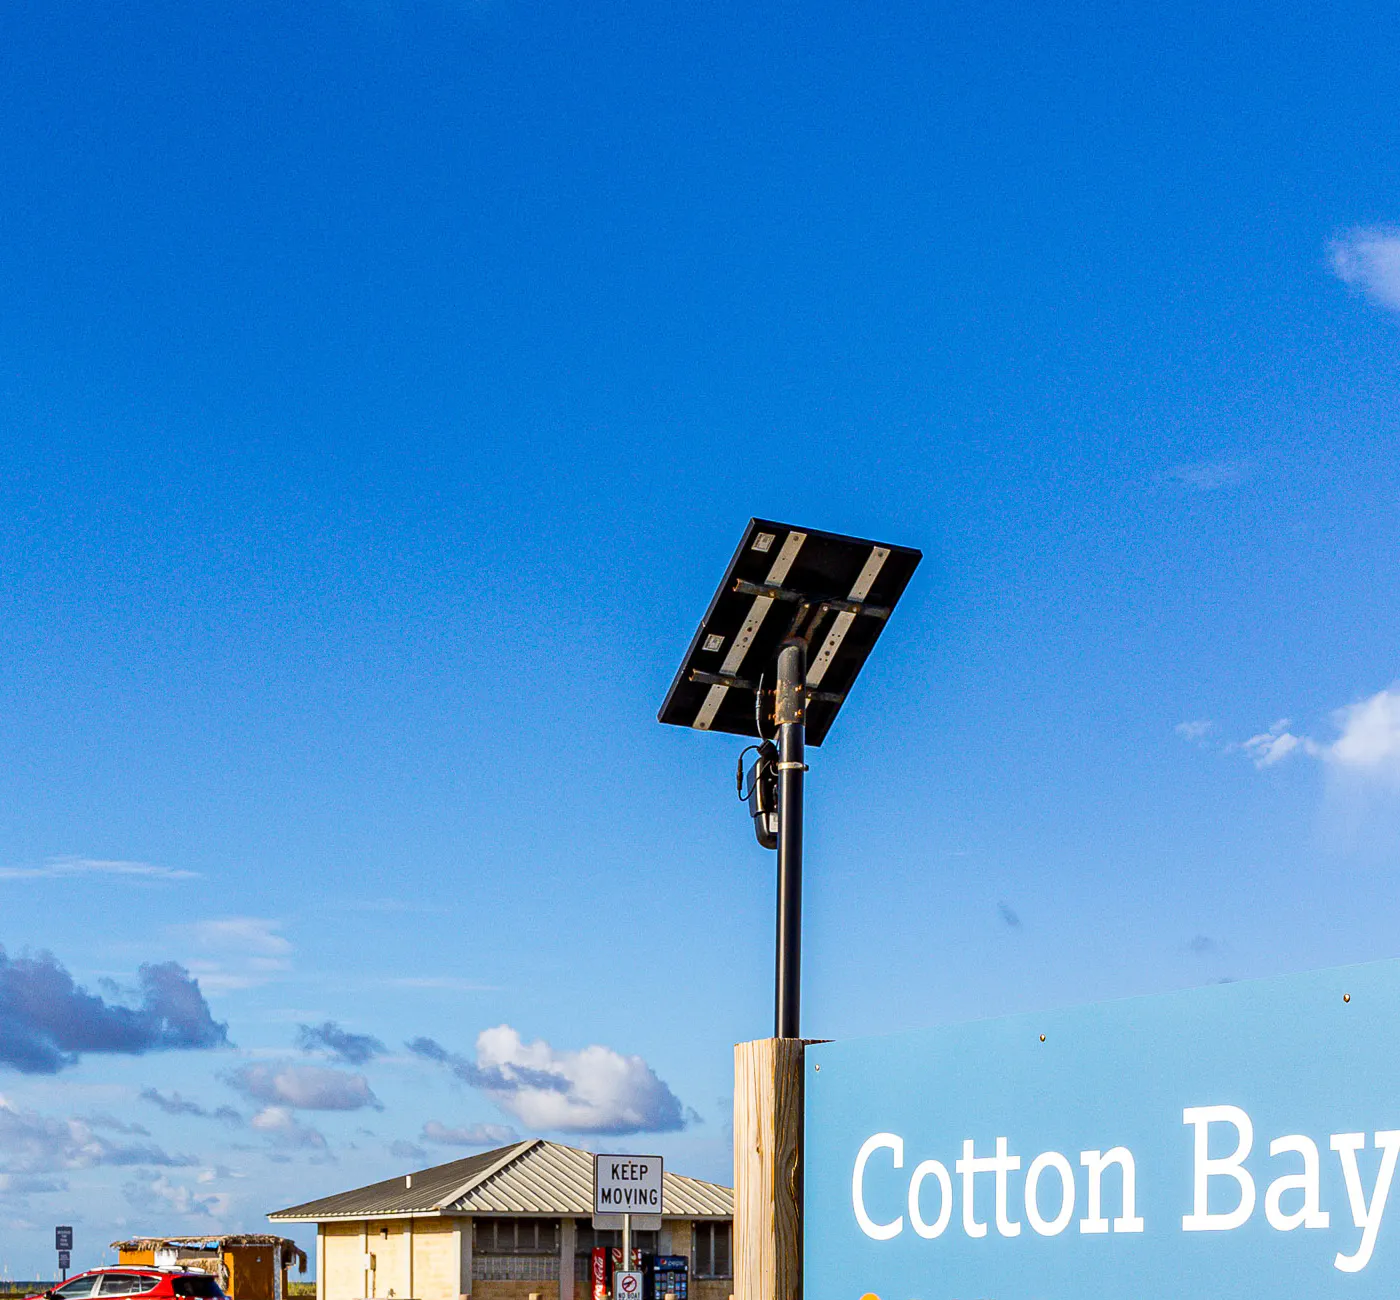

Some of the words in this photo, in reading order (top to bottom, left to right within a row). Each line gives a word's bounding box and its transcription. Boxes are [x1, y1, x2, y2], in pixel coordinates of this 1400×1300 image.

[611, 1163, 648, 1181] KEEP
[601, 1187, 658, 1206] MOVING
[852, 1132, 1144, 1241] Cotton
[1182, 1105, 1400, 1273] Bay
